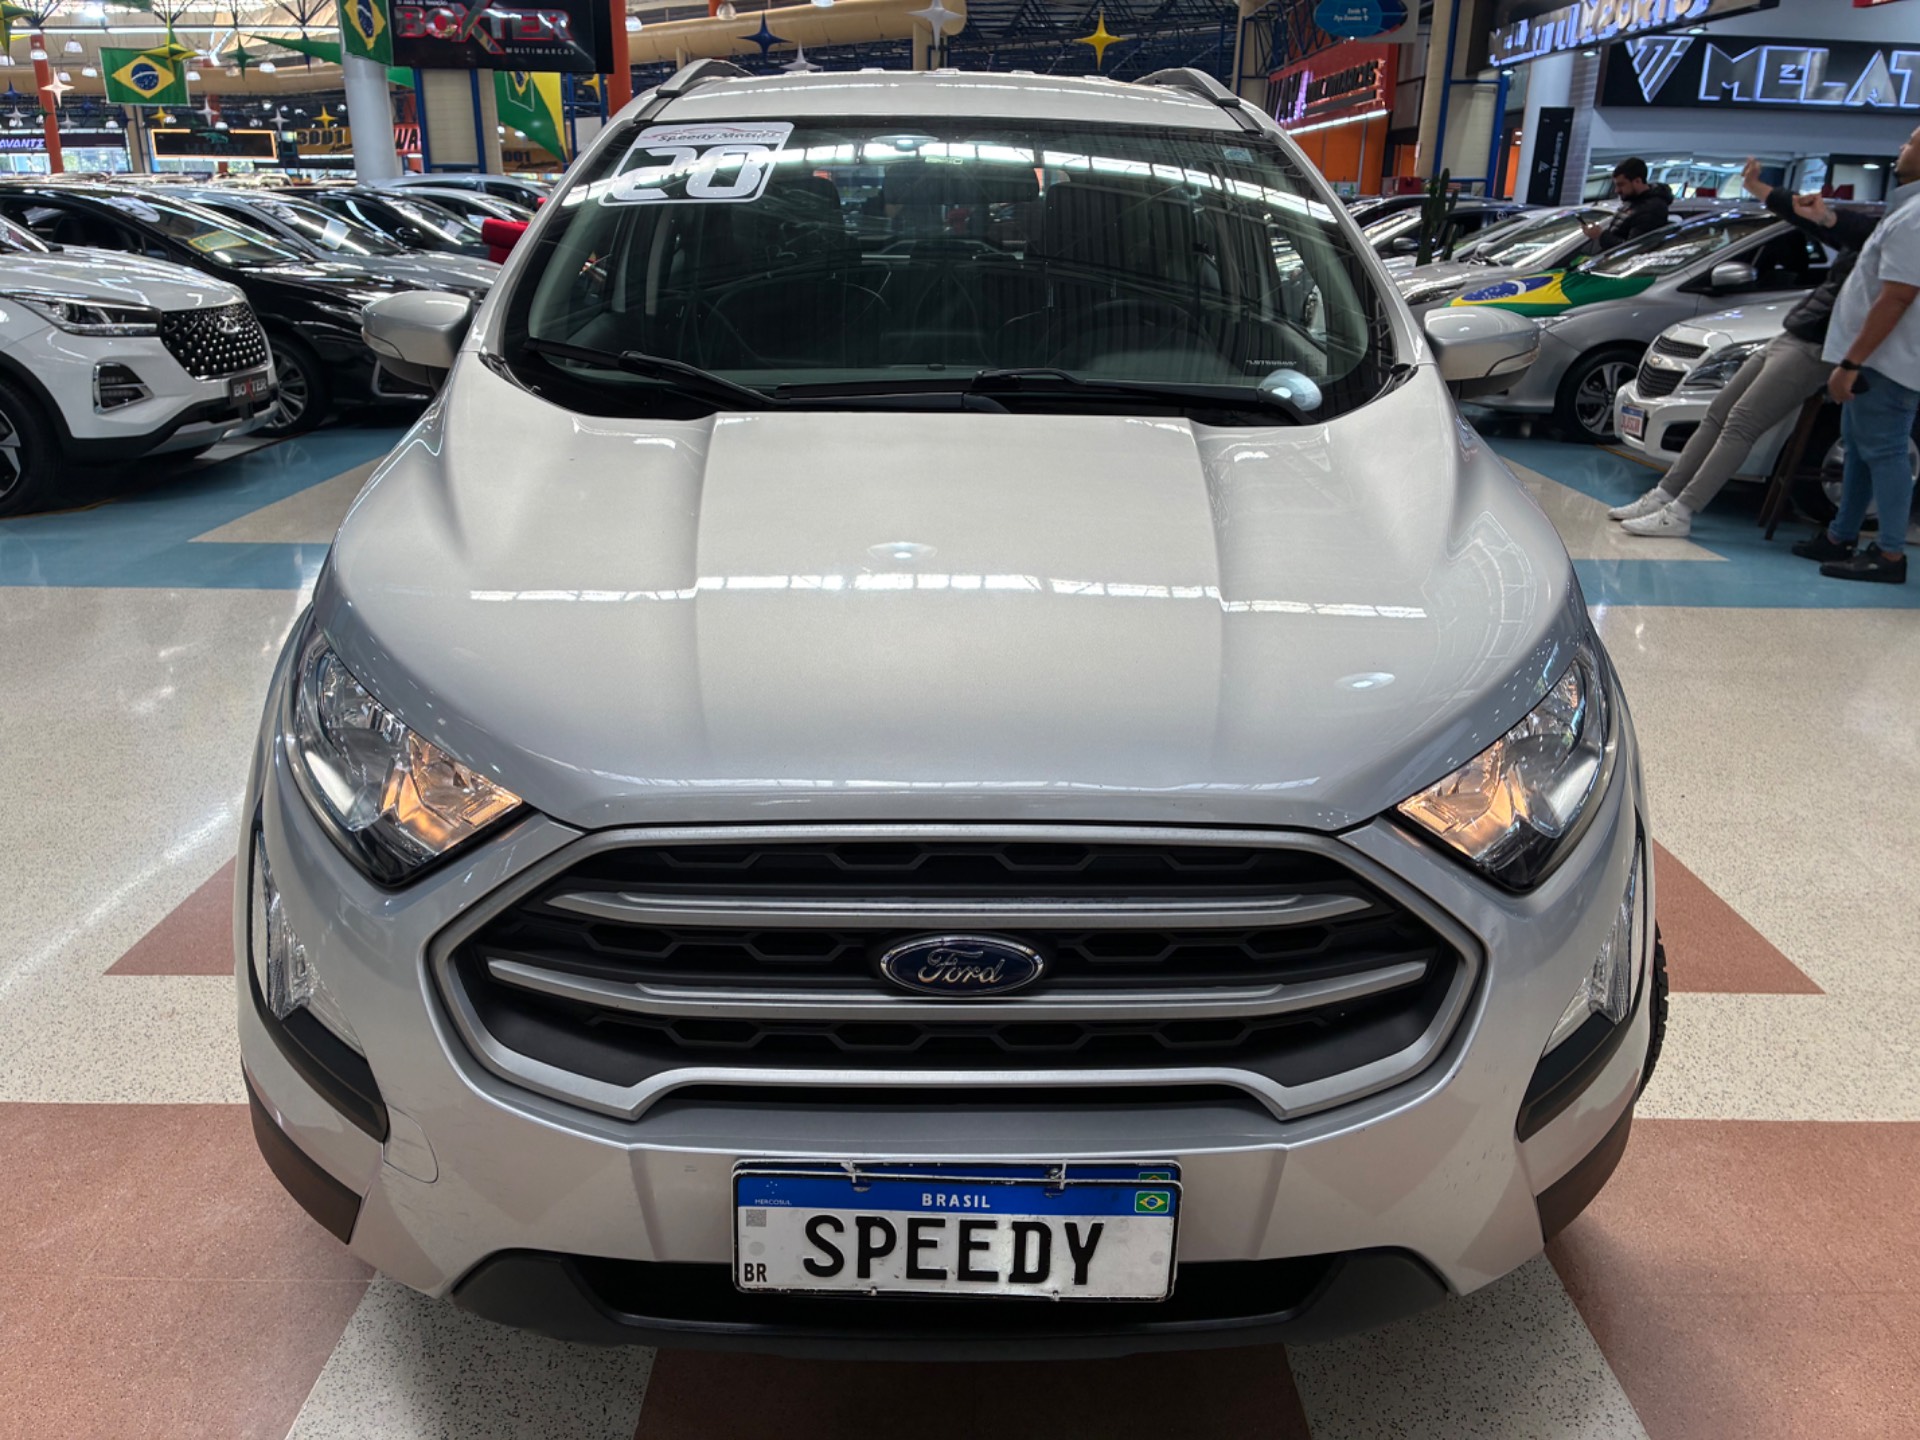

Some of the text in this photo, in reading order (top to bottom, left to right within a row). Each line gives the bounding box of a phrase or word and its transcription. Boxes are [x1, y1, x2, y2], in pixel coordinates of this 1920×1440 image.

[395, 2, 574, 54] BOXTER
[505, 46, 576, 56] MULTIMARCAS
[658, 133, 716, 142] Speedy
[611, 145, 770, 200] 20
[233, 378, 267, 401] BOXTER
[917, 948, 1005, 984] Ford
[754, 1198, 792, 1206] MERCOSUL
[921, 1193, 991, 1209] BRASIL
[802, 1215, 1105, 1286] SPEEDY
[743, 1262, 767, 1284] BR
